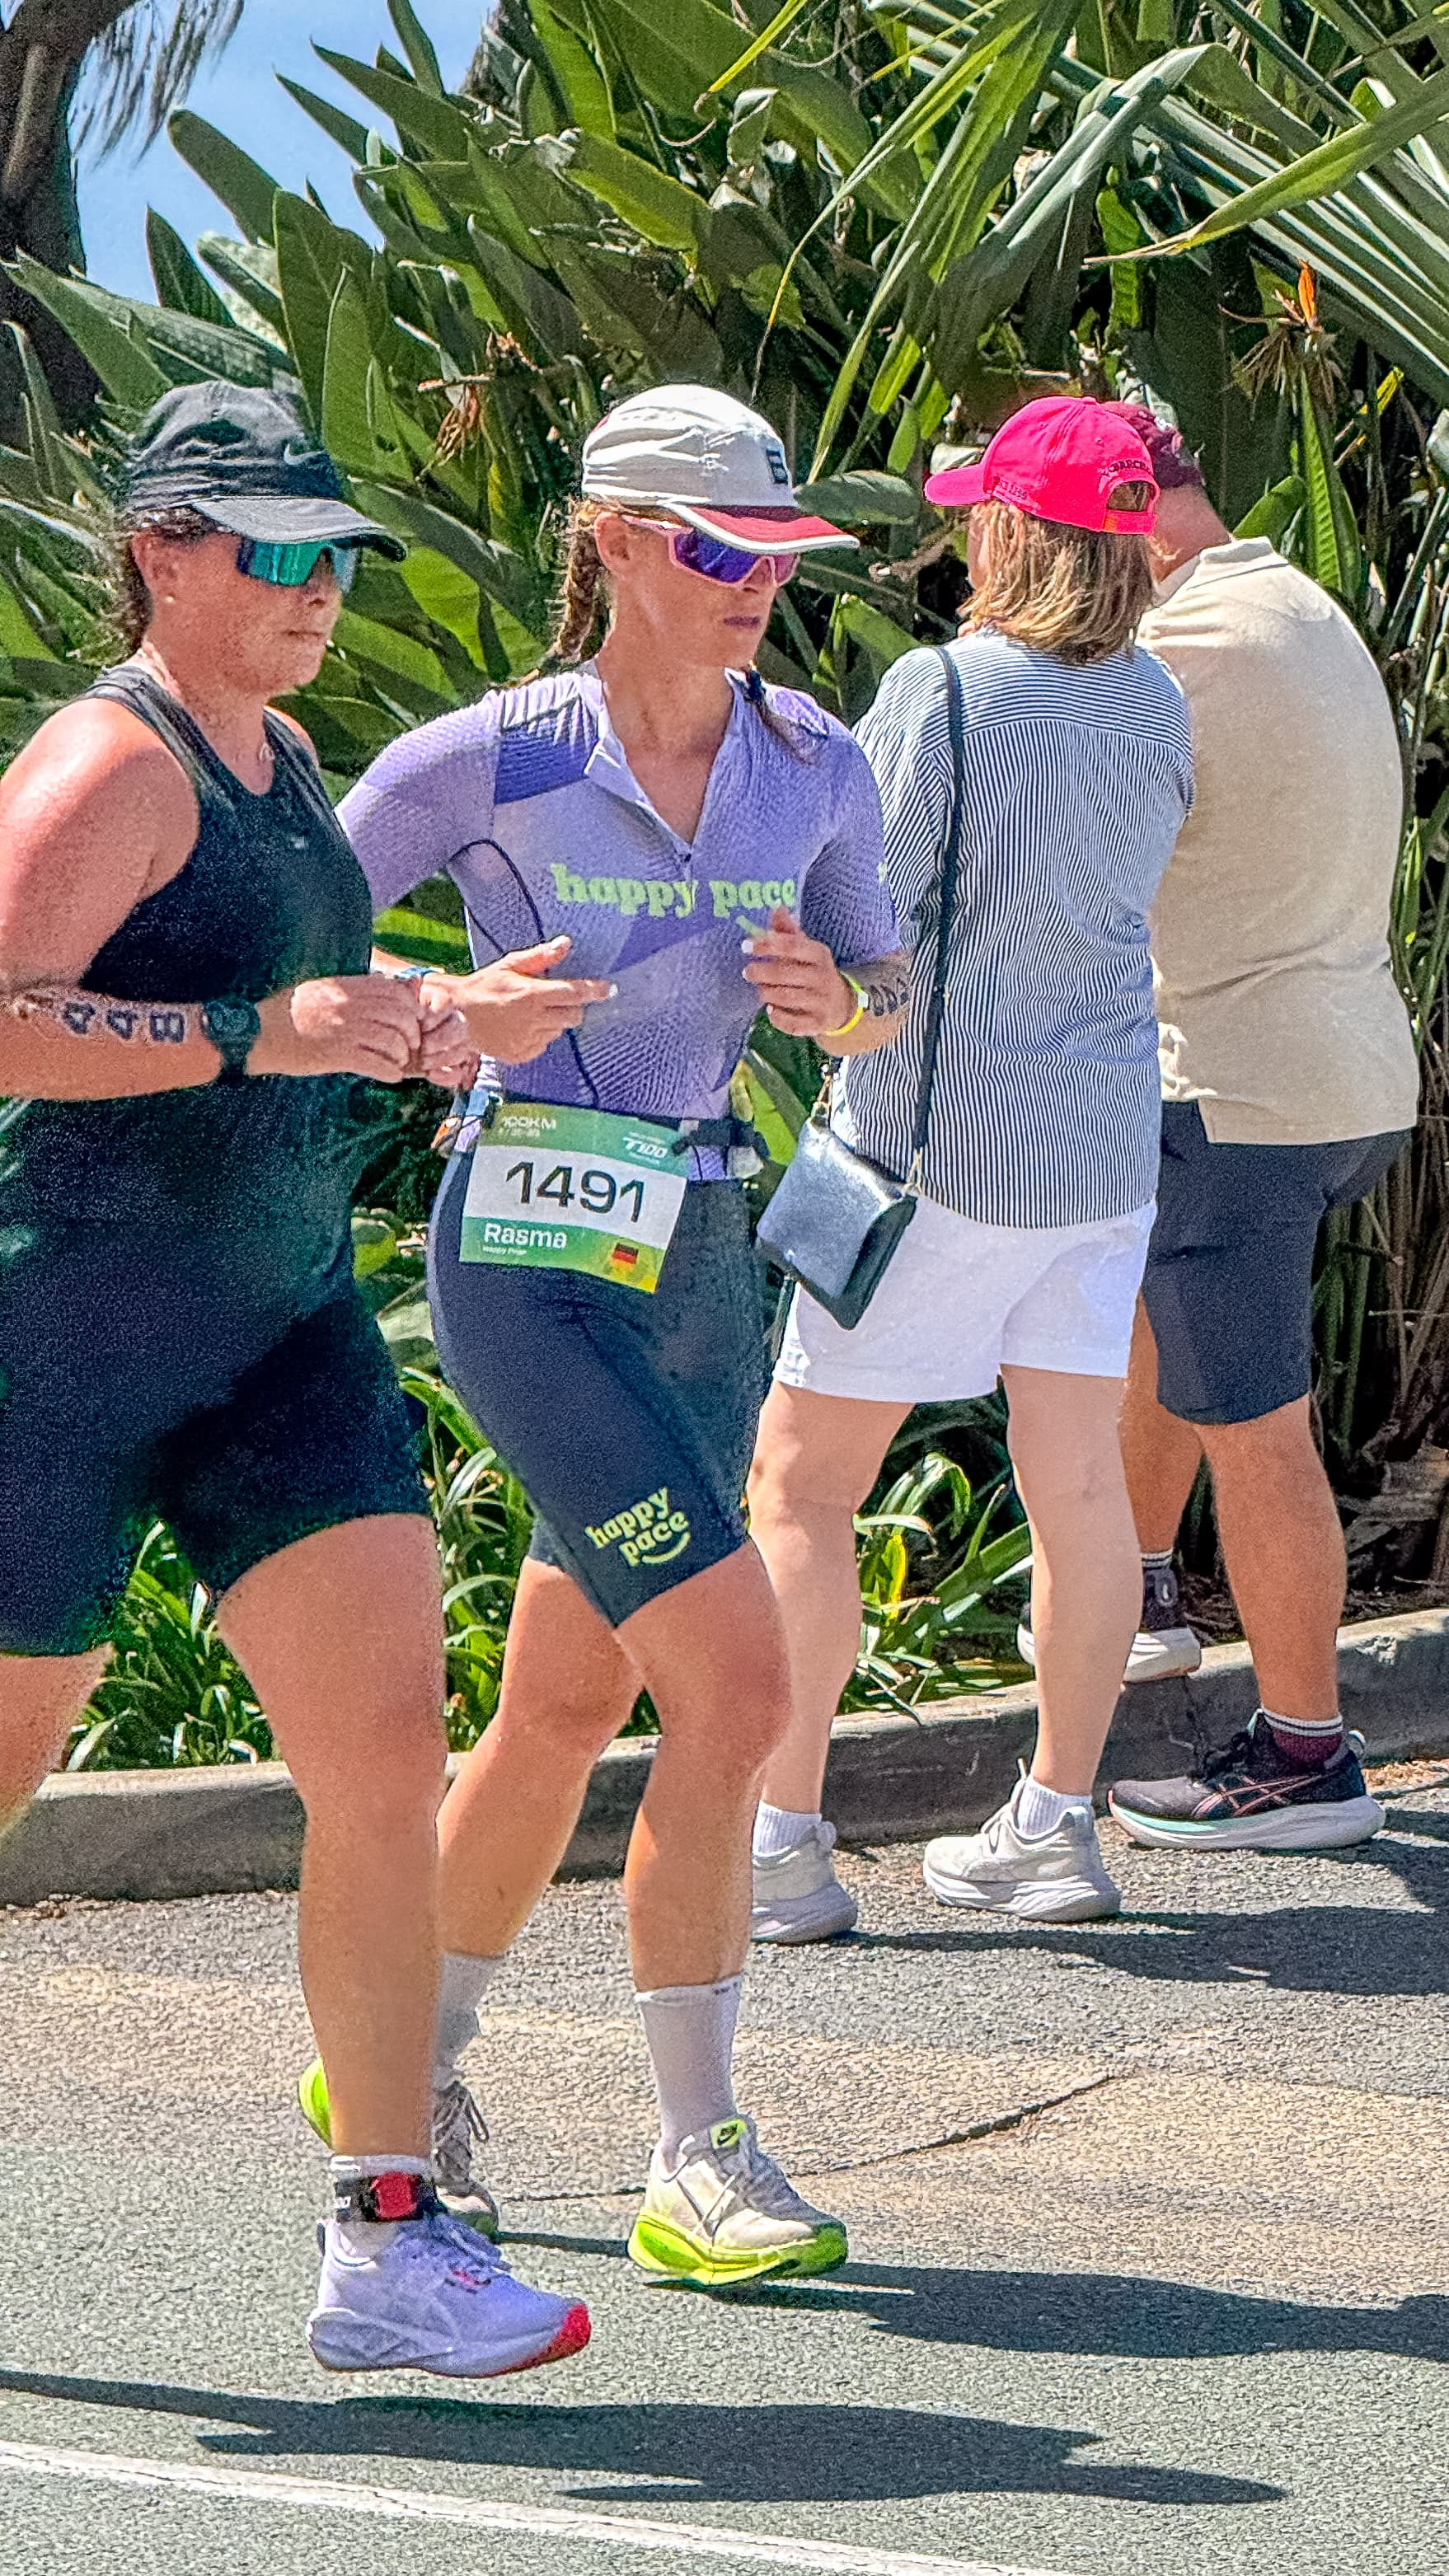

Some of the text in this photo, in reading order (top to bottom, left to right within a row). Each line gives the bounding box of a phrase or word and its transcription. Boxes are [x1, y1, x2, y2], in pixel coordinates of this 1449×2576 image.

[550, 862, 796, 918] happy pace
[622, 1136, 668, 1159] T100
[506, 1161, 645, 1224] 1491
[484, 1223, 568, 1249] Rasma
[584, 1487, 669, 1550] happy
[618, 1511, 689, 1567] pace
